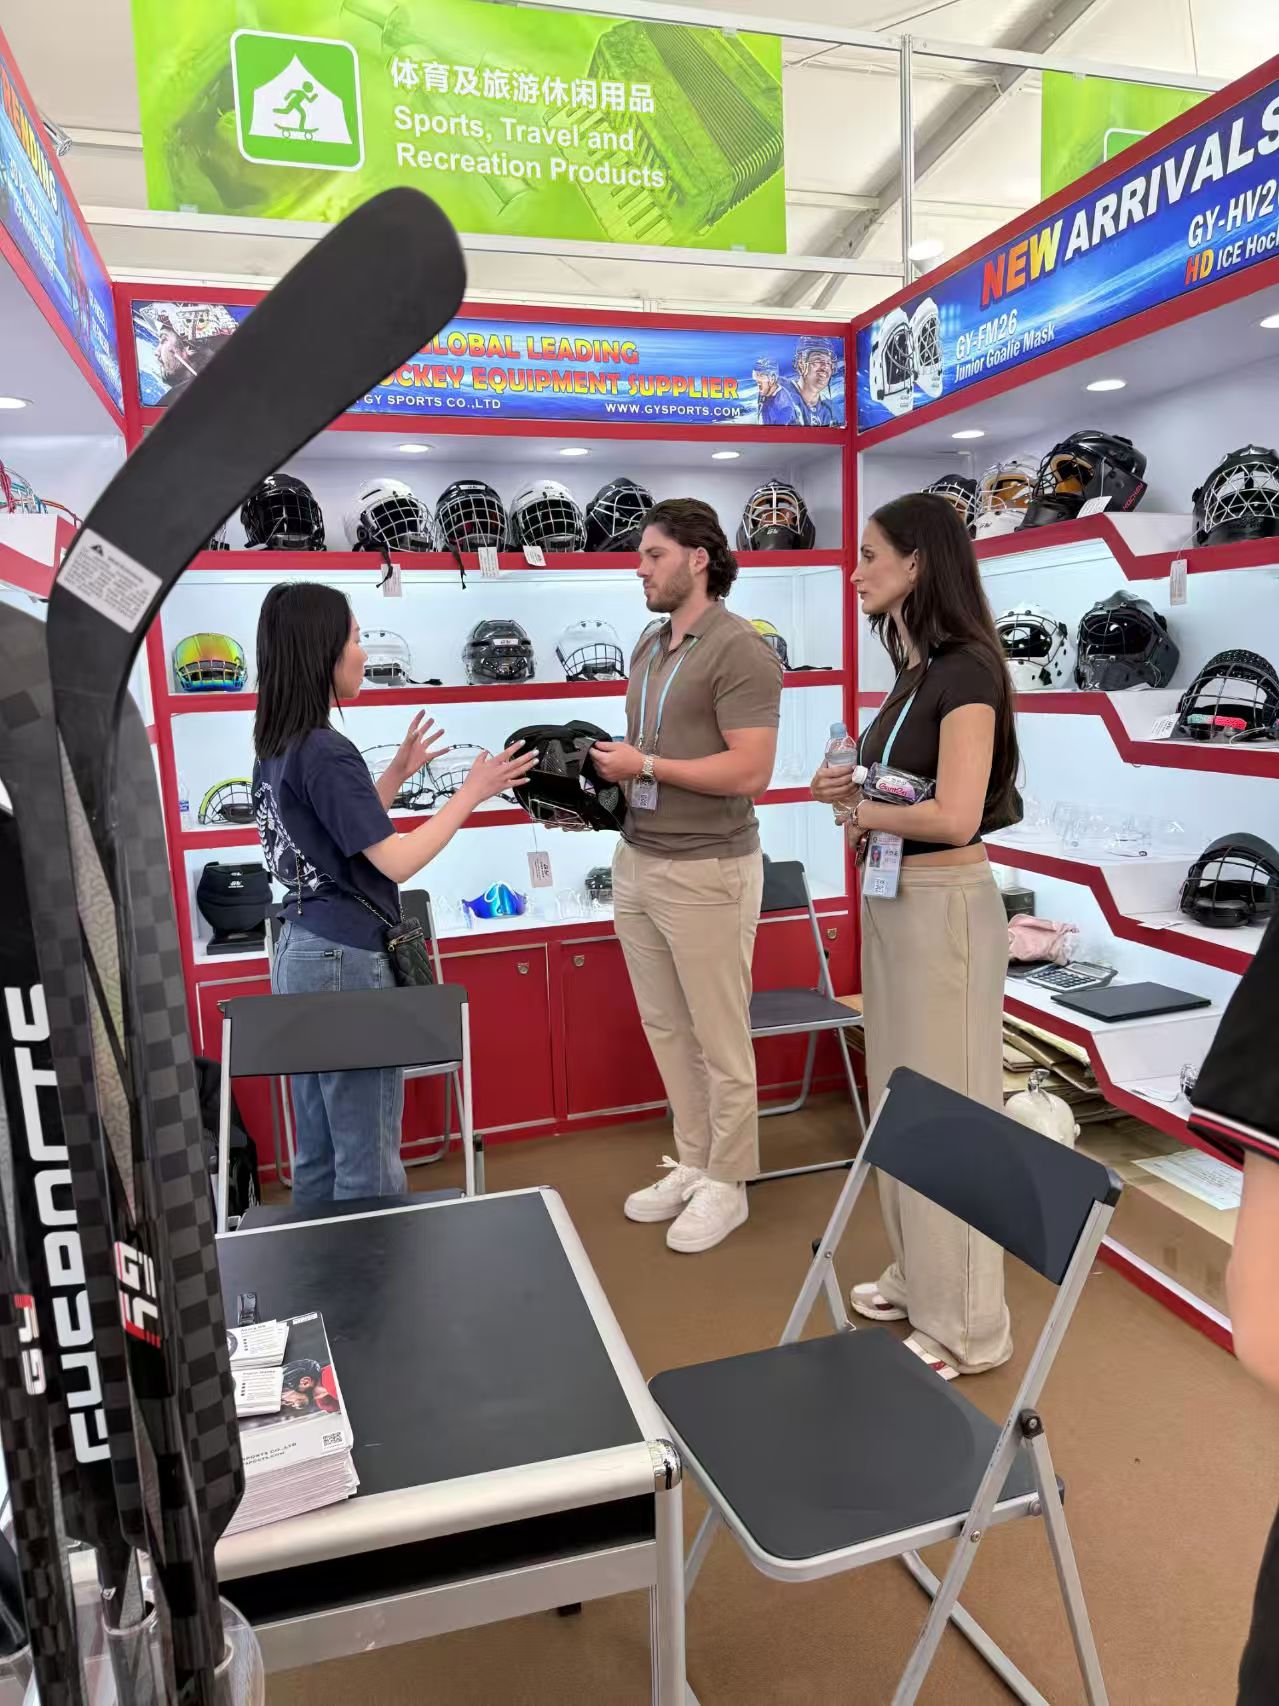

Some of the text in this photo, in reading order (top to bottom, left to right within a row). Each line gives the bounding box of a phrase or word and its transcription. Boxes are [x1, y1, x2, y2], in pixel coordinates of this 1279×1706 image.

[391, 56, 655, 113] 体育及旅游休闲用品
[394, 105, 634, 152] Sports, Travel and
[397, 142, 665, 188] Recreation Products
[981, 96, 1279, 306] NEW ARRIVALS
[1188, 178, 1279, 248] GY-HV2
[1185, 248, 1214, 286] HD
[1216, 240, 1243, 271] ICE
[418, 332, 639, 365] LOBAL LEADING
[954, 322, 1055, 383] Junior Goalie Mask
[956, 309, 1018, 360] GY-FM26
[363, 394, 382, 405] GY
[387, 395, 442, 407] SPORTS
[447, 398, 501, 410] CO.,LTD
[378, 363, 739, 400] CKEY EQUIPMENT SUPPLIER
[605, 402, 741, 418] WWW.GYSPORTS.COM
